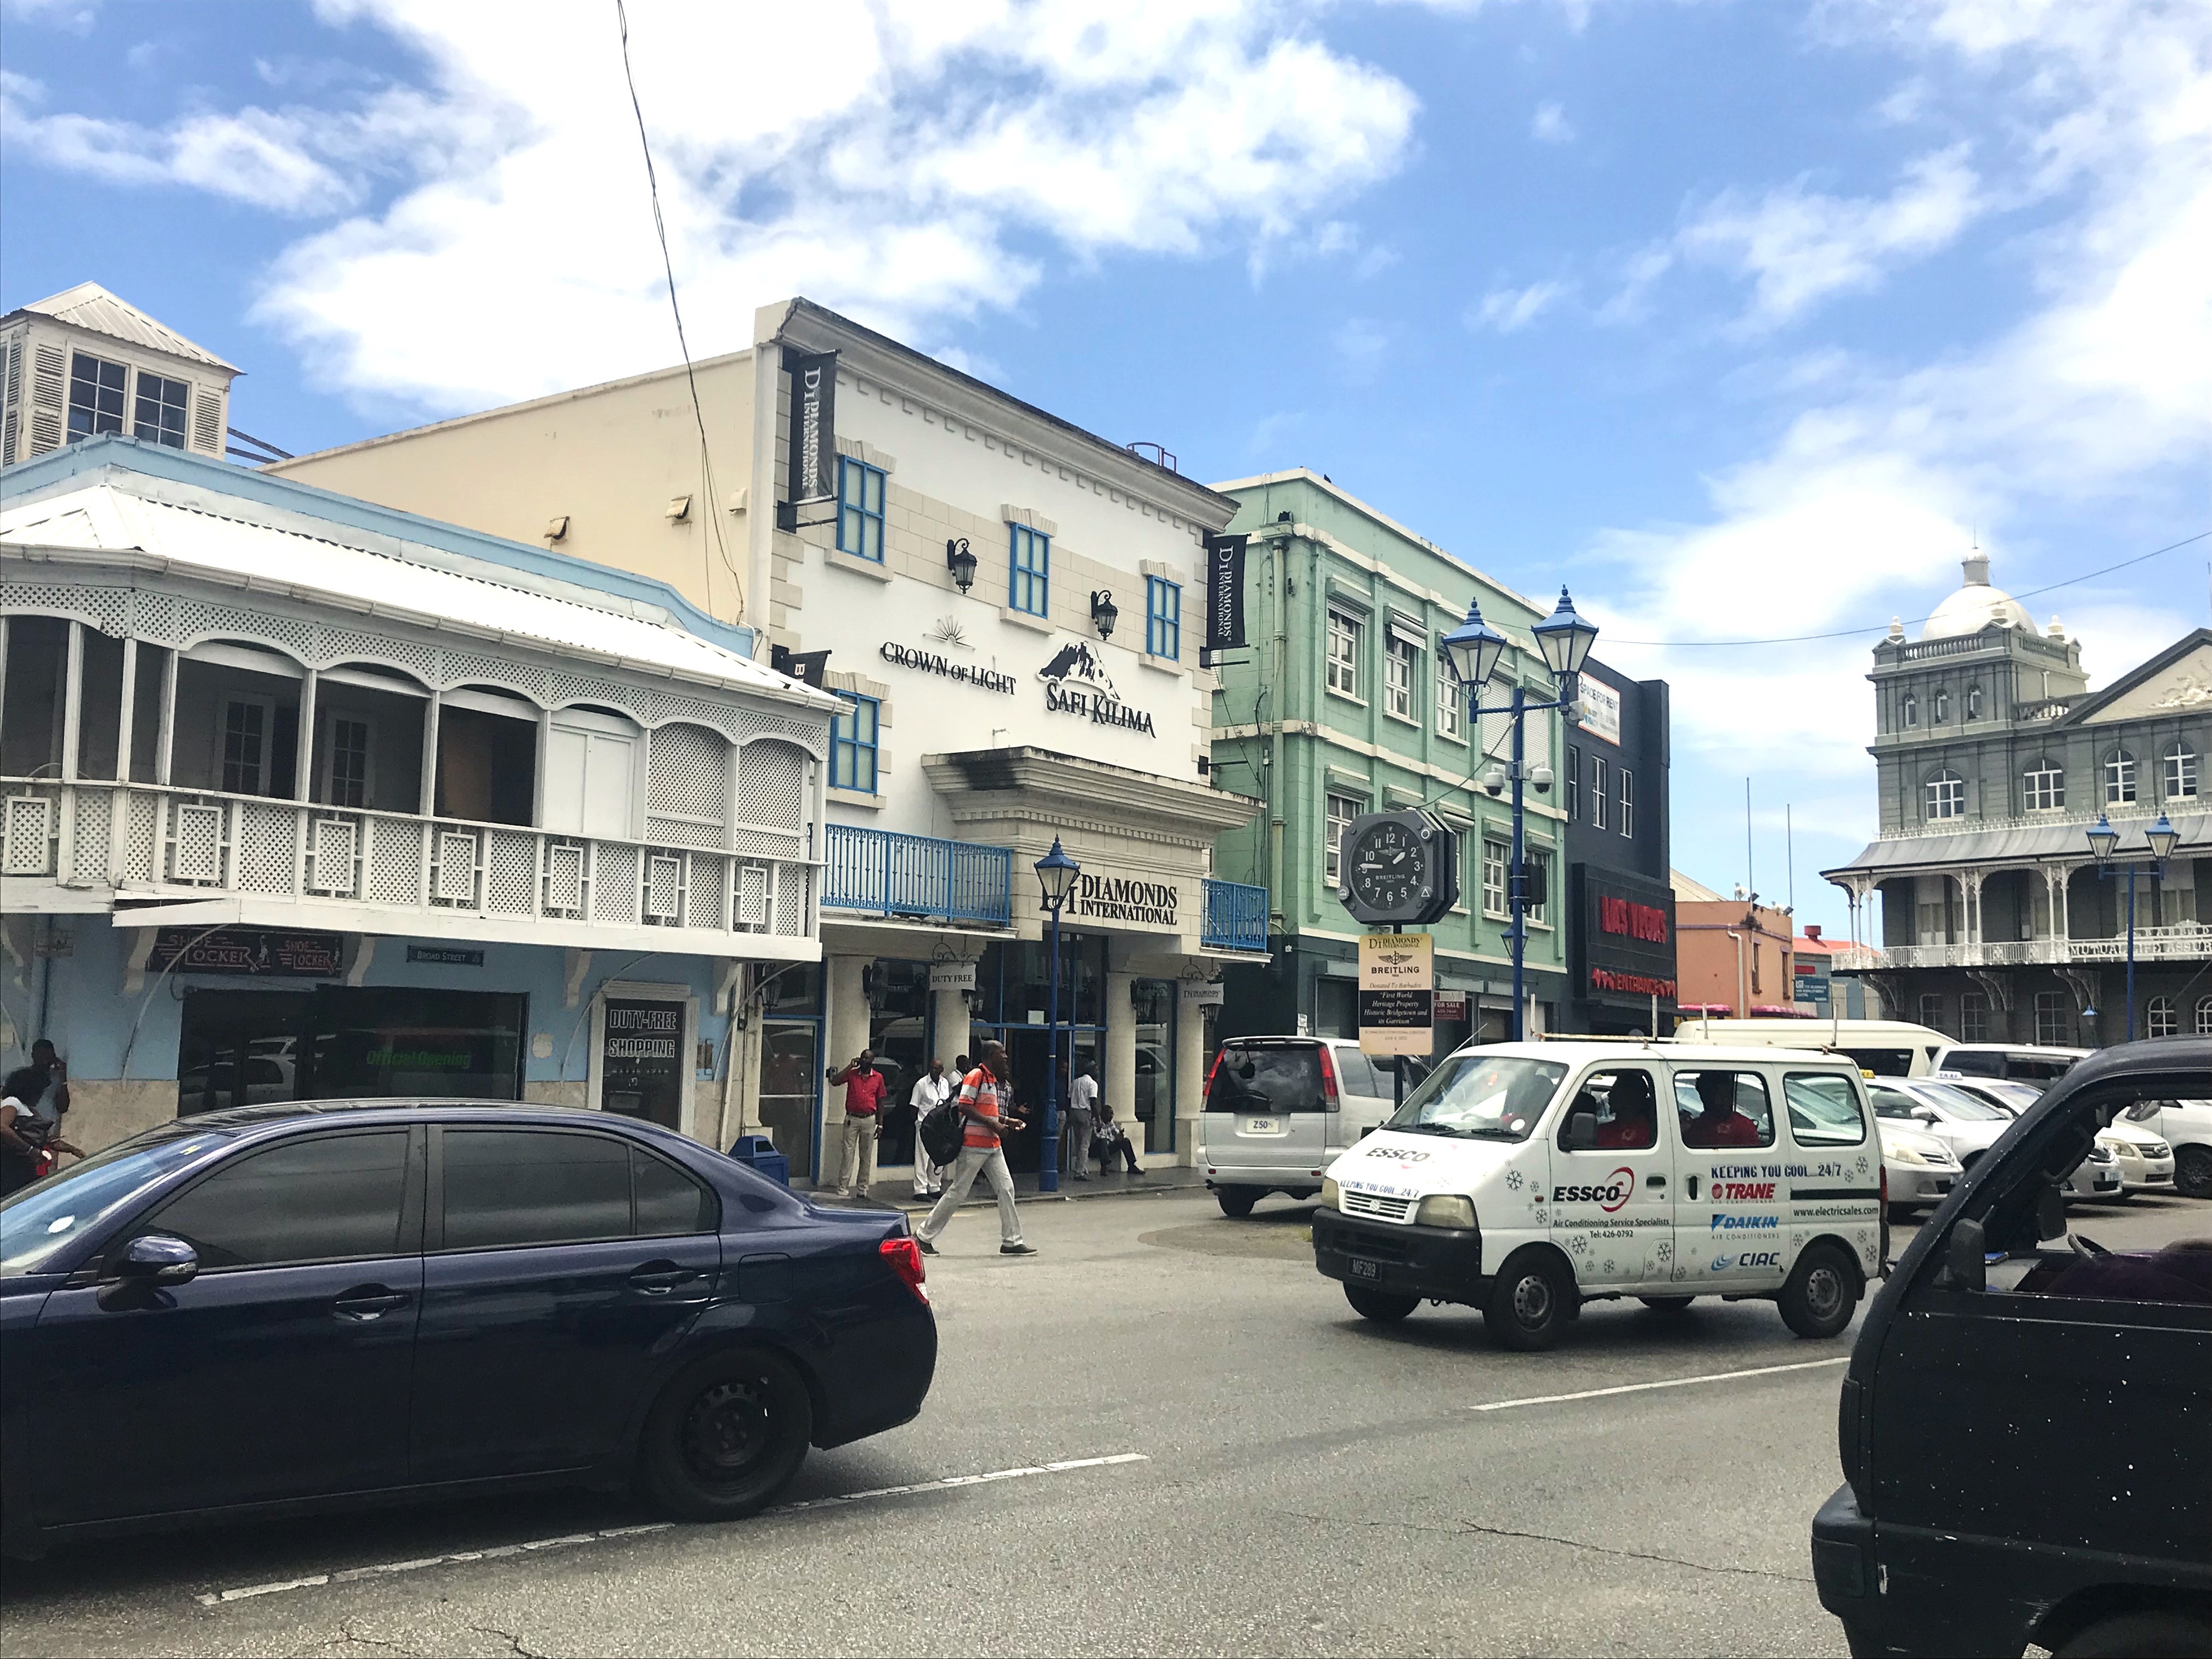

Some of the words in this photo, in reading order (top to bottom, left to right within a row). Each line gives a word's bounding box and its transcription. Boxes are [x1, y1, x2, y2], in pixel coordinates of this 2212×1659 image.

[808, 401, 820, 488] DIAMONDS
[882, 642, 948, 677] CROWN
[970, 665, 1017, 695] LIGHT
[1580, 683, 1596, 701] SPACE
[1596, 690, 1606, 704] FOR
[1606, 696, 1619, 712] RENT
[1047, 682, 1087, 716] SAFI
[1092, 694, 1156, 738] KILIMA
[1386, 833, 1396, 844] 12
[1365, 850, 1375, 861] 10
[1410, 847, 1417, 857] 2
[1414, 861, 1420, 871] 3
[1365, 877, 1371, 888] 8
[1410, 875, 1417, 885] 4
[1080, 873, 1178, 909] DIAMONDS
[1374, 887, 1381, 898] 7
[1387, 891, 1393, 902] 6
[1401, 887, 1407, 898] 5
[1080, 899, 1178, 926] INTERNATIONAL
[1601, 895, 1628, 935] LAS
[168, 934, 212, 947] SHOE
[284, 940, 309, 952] SHOE
[185, 947, 259, 973] LOCKER
[293, 950, 335, 973] LOCKER
[417, 951, 440, 960] BROAD
[442, 952, 466, 962] STREET
[1617, 974, 1659, 996] ENTRANCE
[1372, 1000, 1395, 1008] Heritage
[1396, 1000, 1419, 1008] Property
[609, 1009, 676, 1030] DUTY-FREE
[1386, 1009, 1417, 1017] Bridgetown
[608, 1037, 675, 1058] SHOPPING
[1365, 1147, 1431, 1162] ESSCO
[1711, 1165, 1757, 1178] KEEPING
[1760, 1164, 1781, 1178] YOU
[1339, 1180, 1364, 1189] KEEPING
[1365, 1182, 1379, 1192] YOU
[1725, 1183, 1776, 1199] TRANE
[1553, 1186, 1620, 1201] ESSCO
[1793, 1205, 1878, 1217] www.electricsales.com
[1553, 1219, 1563, 1228] Air
[1565, 1218, 1609, 1228] Conditioning
[1635, 1217, 1669, 1227] Specialists
[1724, 1216, 1779, 1229] DAIKIN
[1589, 1230, 1602, 1238] Tel:
[1602, 1229, 1634, 1238] 426-0792
[1739, 1252, 1780, 1267] CIAC
